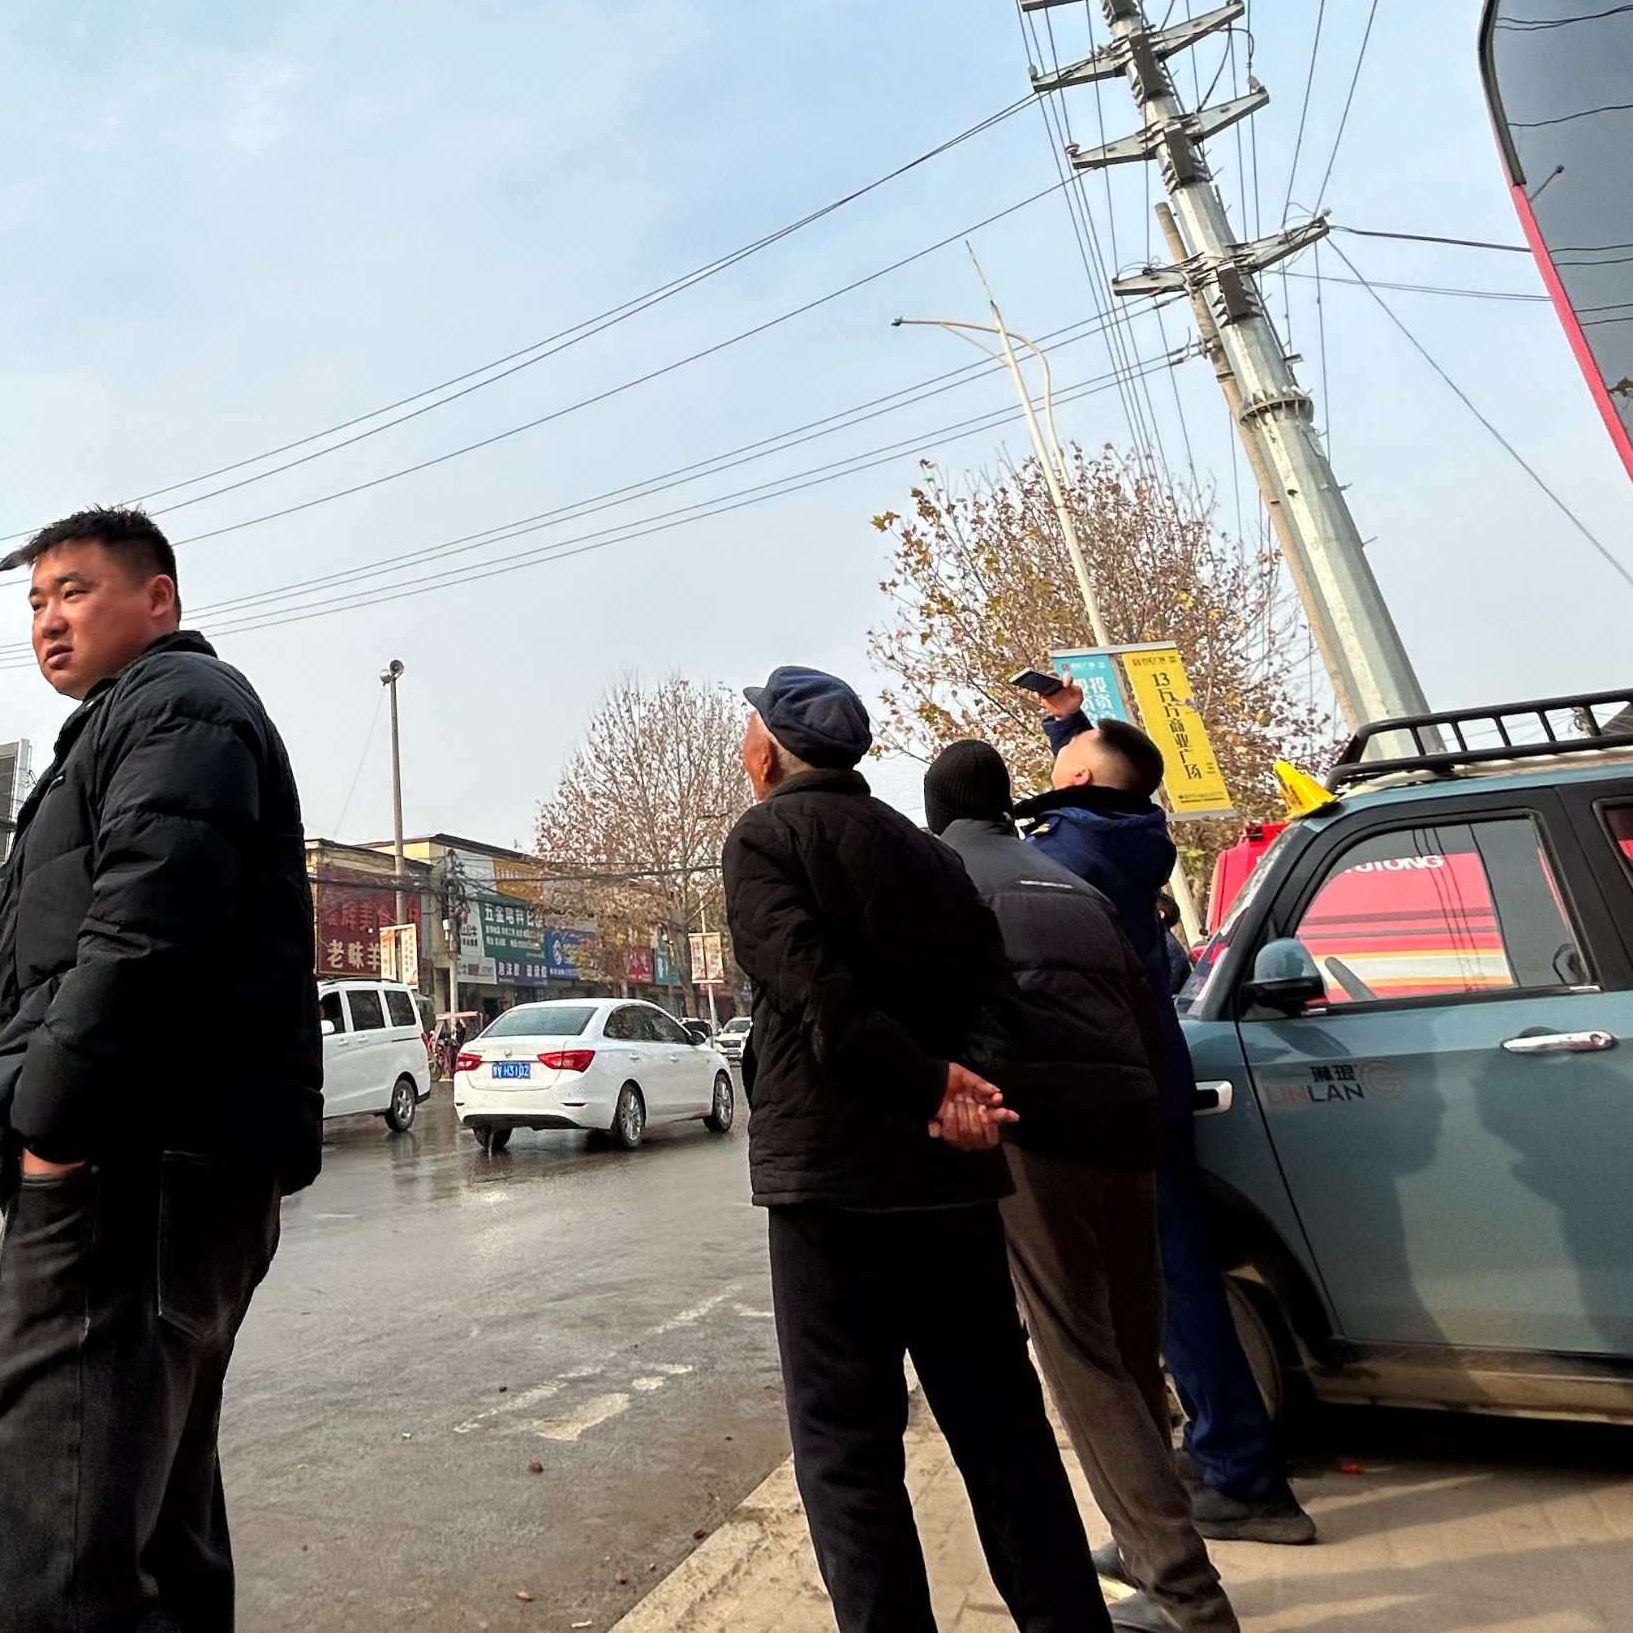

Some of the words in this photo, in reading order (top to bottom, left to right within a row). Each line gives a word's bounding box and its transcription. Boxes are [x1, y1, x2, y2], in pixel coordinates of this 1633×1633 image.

[1152, 671, 1202, 780] 13万方商业广场
